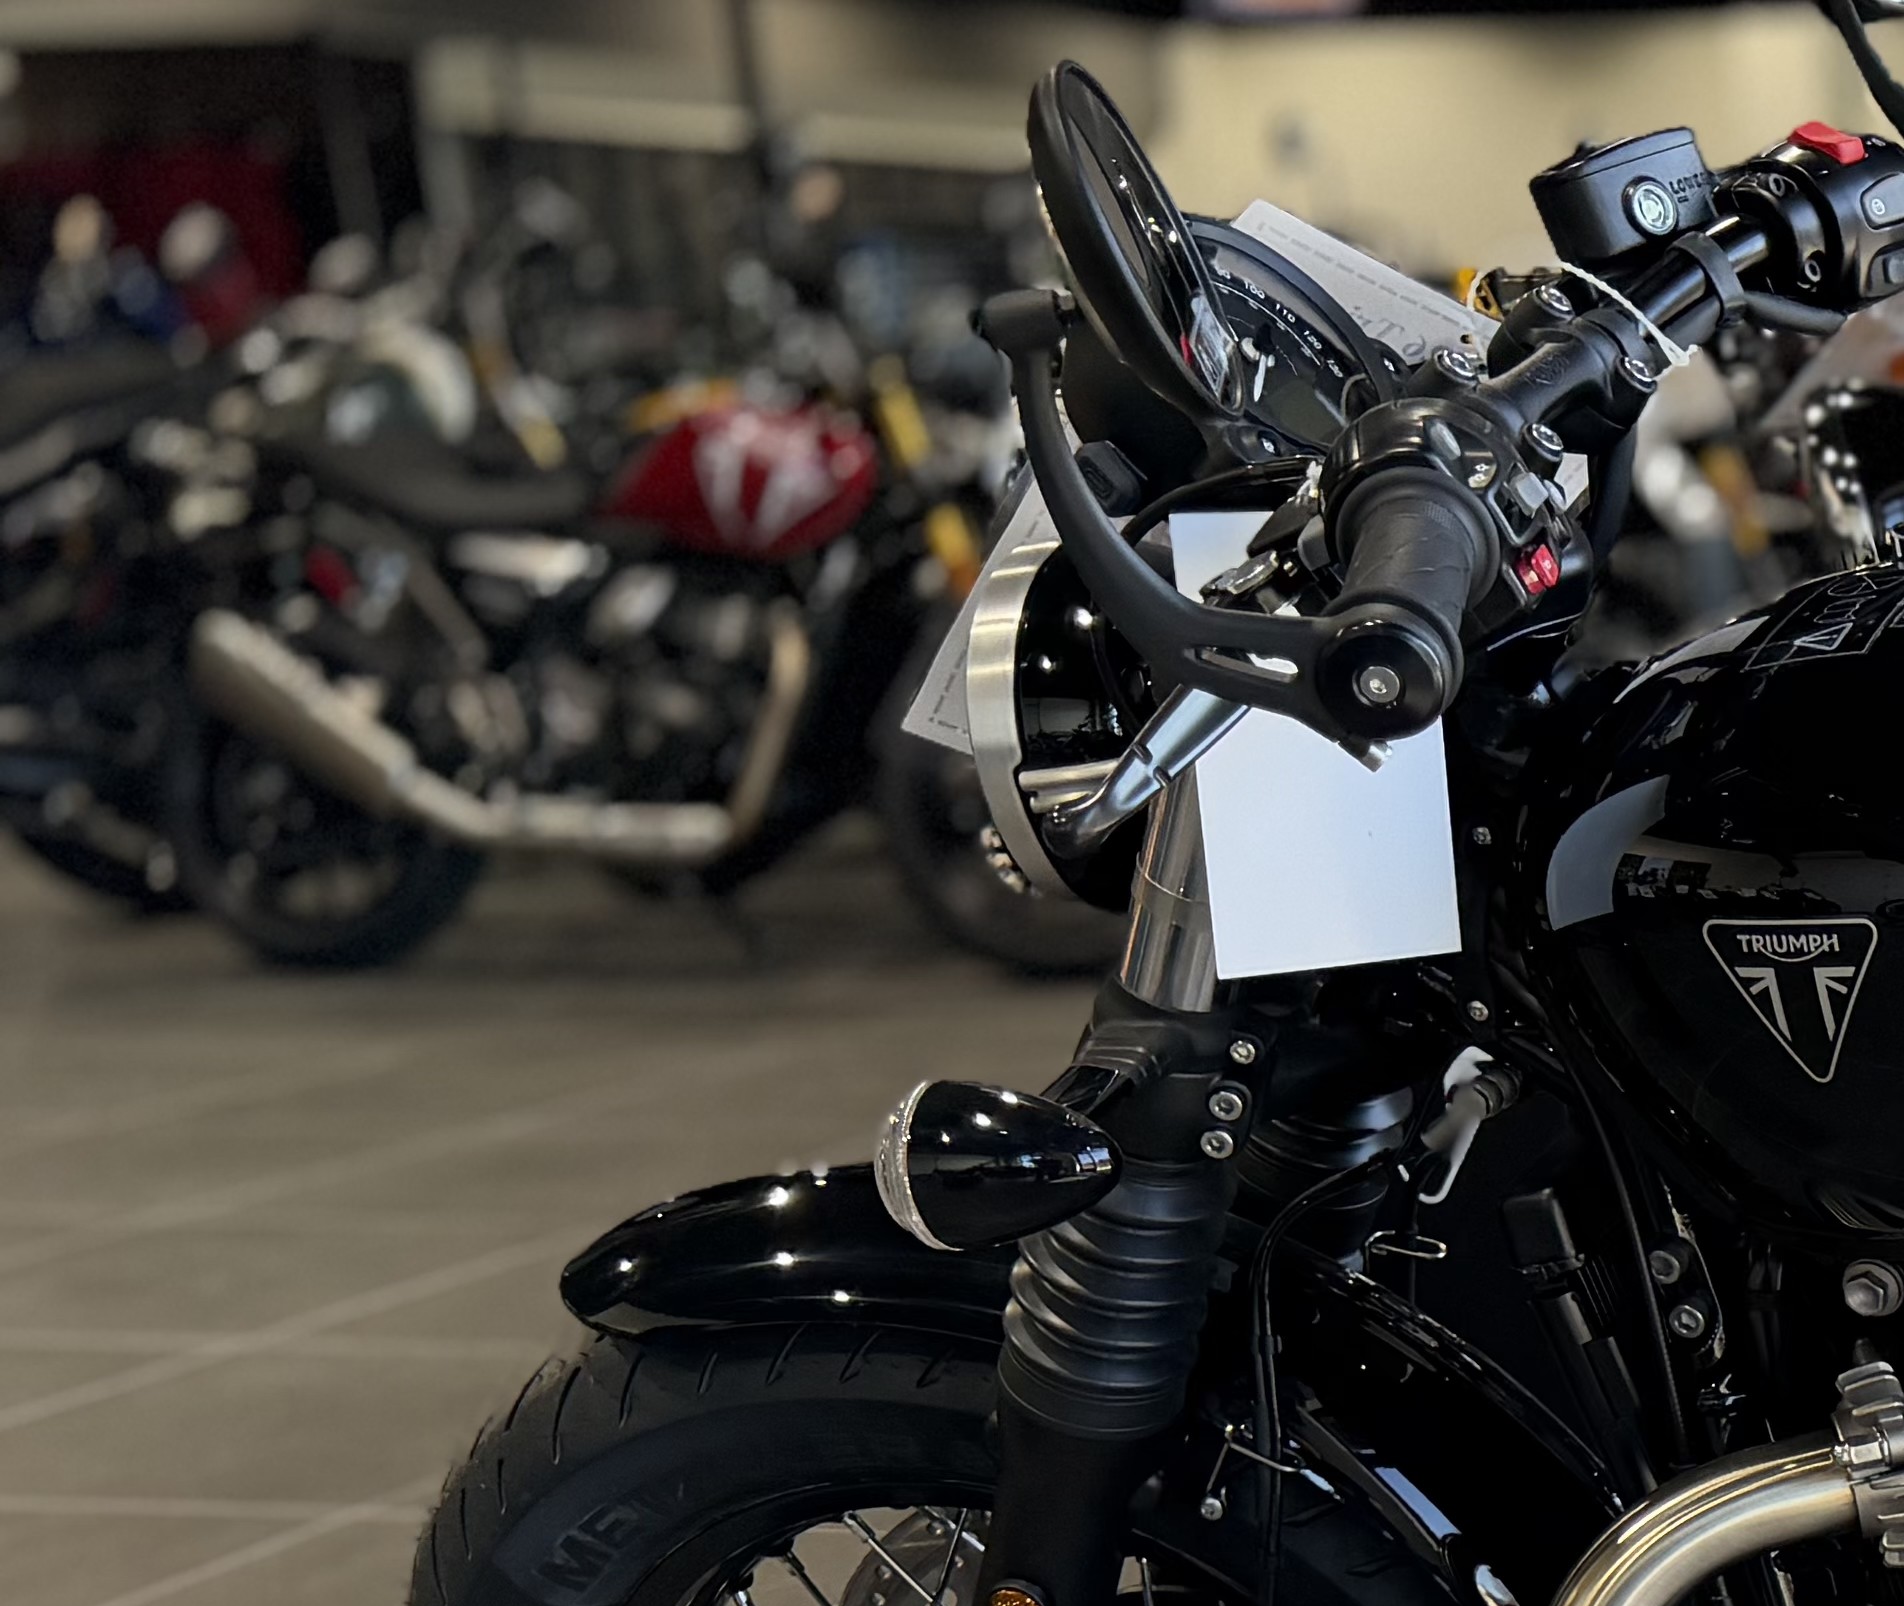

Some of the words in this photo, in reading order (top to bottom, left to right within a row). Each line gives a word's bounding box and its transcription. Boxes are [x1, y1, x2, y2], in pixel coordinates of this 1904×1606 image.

[1244, 280, 1266, 300] 100
[1275, 303, 1296, 323] 110
[1303, 330, 1323, 351] 120
[1736, 933, 1840, 962] TRIUMPH
